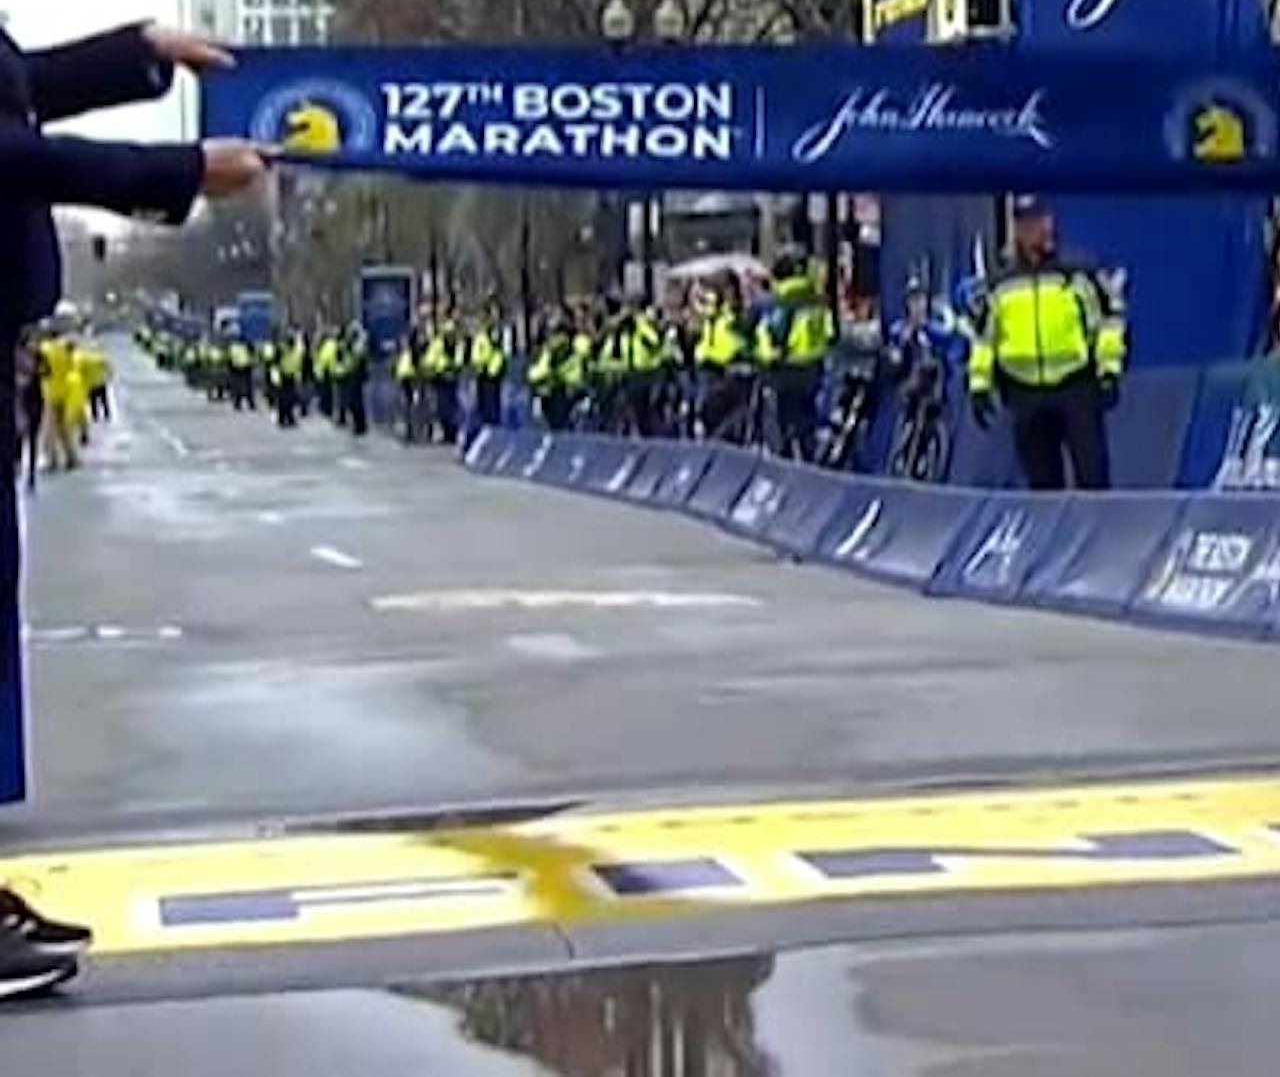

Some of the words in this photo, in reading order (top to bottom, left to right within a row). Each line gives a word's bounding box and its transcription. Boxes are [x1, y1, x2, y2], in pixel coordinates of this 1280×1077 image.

[378, 81, 504, 121] 127TH
[511, 81, 732, 122] BOSTON
[381, 122, 733, 160] MARATHON
